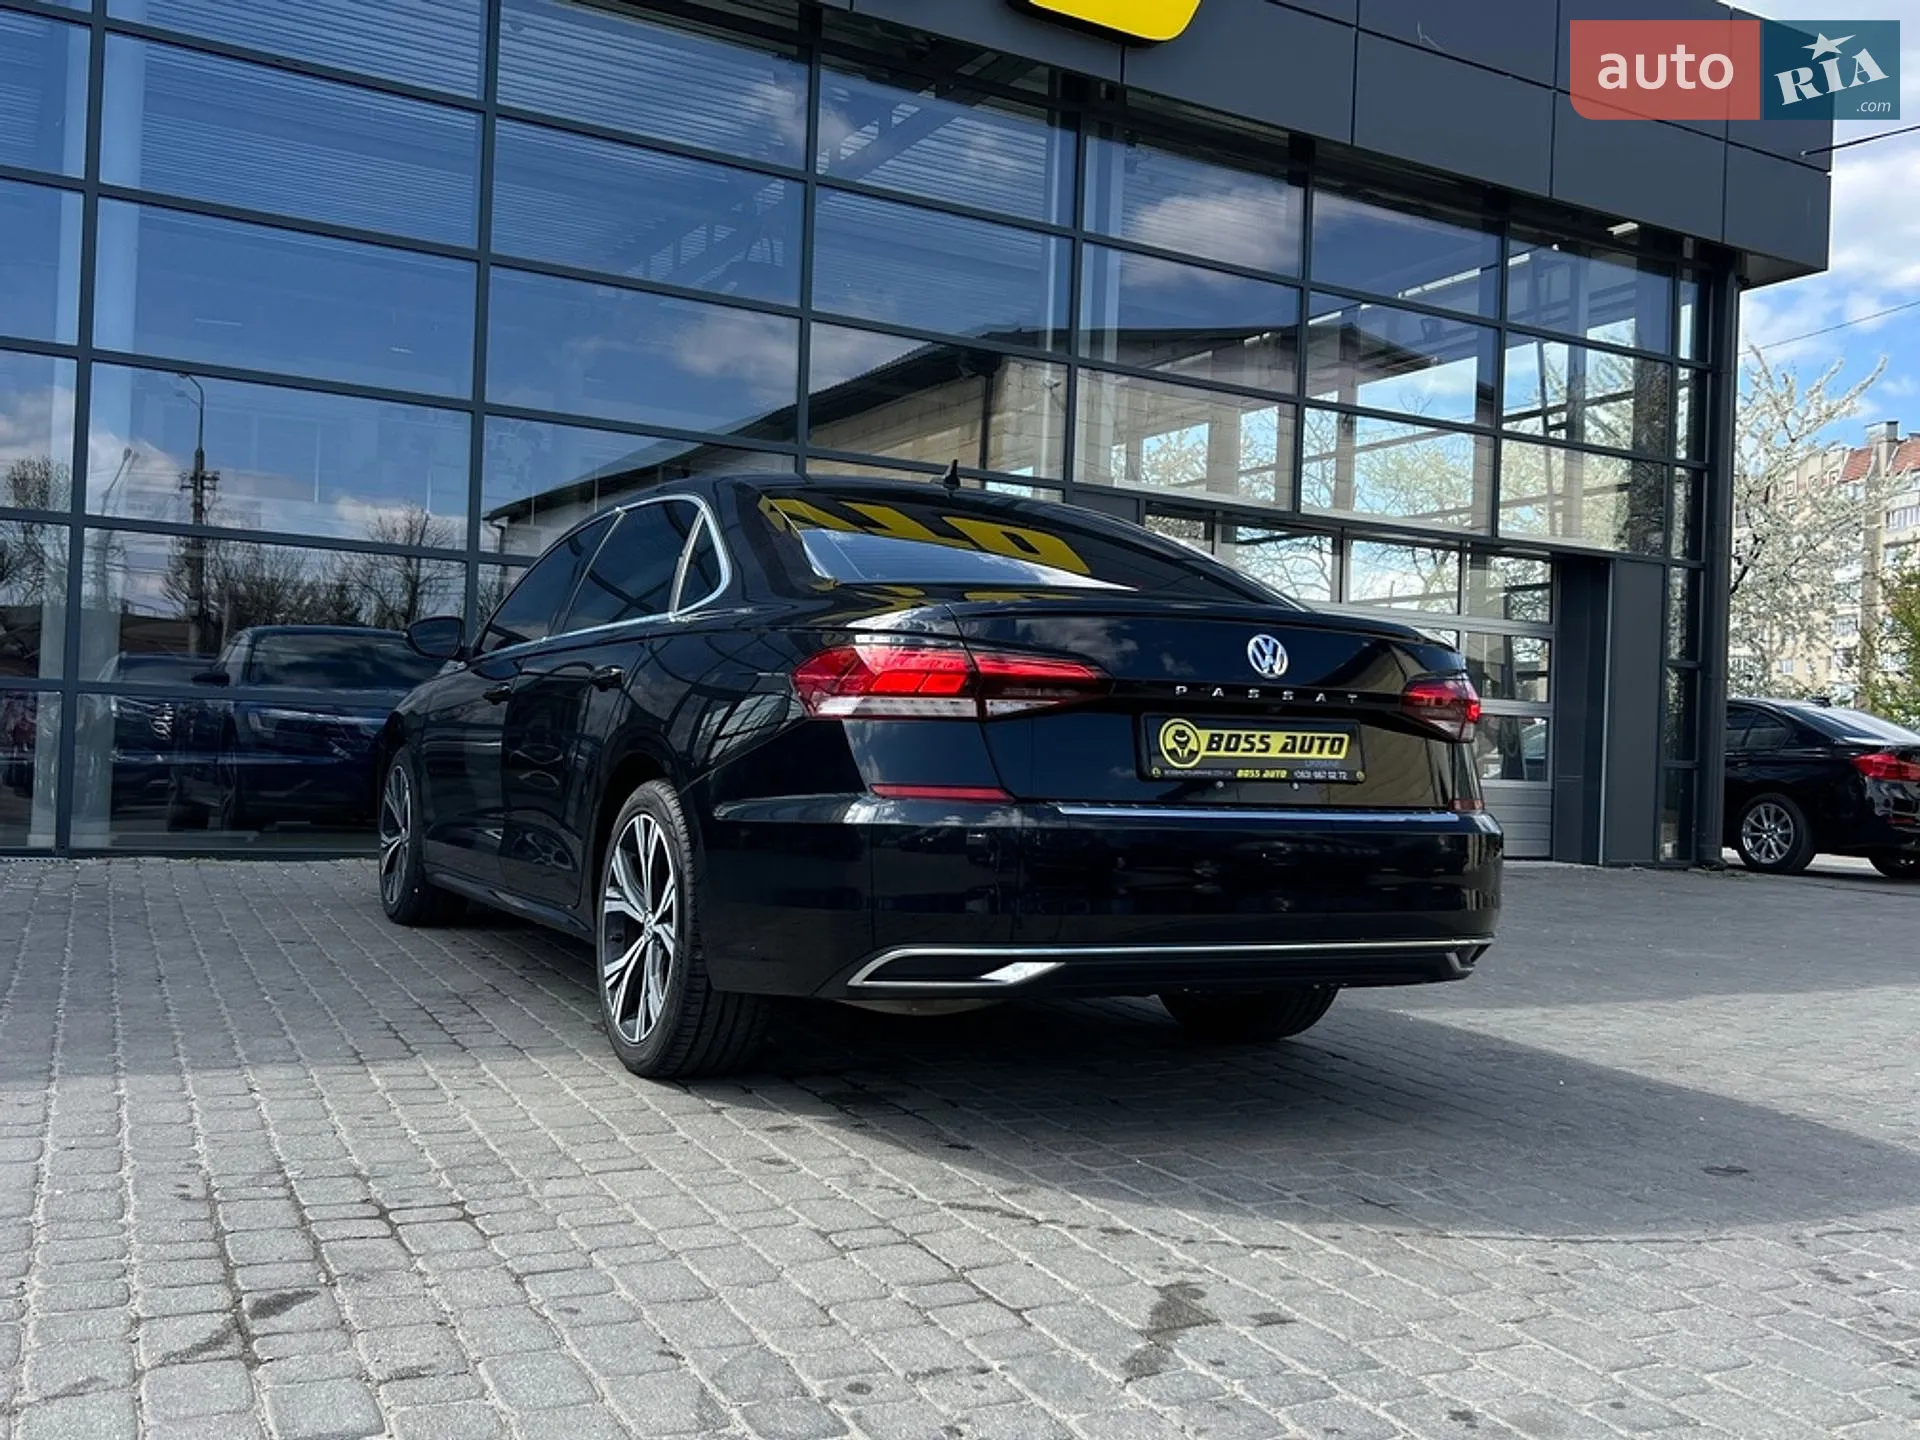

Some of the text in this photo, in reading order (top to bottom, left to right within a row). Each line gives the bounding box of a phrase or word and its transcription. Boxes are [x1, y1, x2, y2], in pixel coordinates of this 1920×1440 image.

[1175, 685, 1358, 704] PASSAT
[1206, 733, 1345, 755] BOSS AUTO
[1236, 769, 1260, 778] BOSS
[1262, 769, 1287, 779] AUTO
